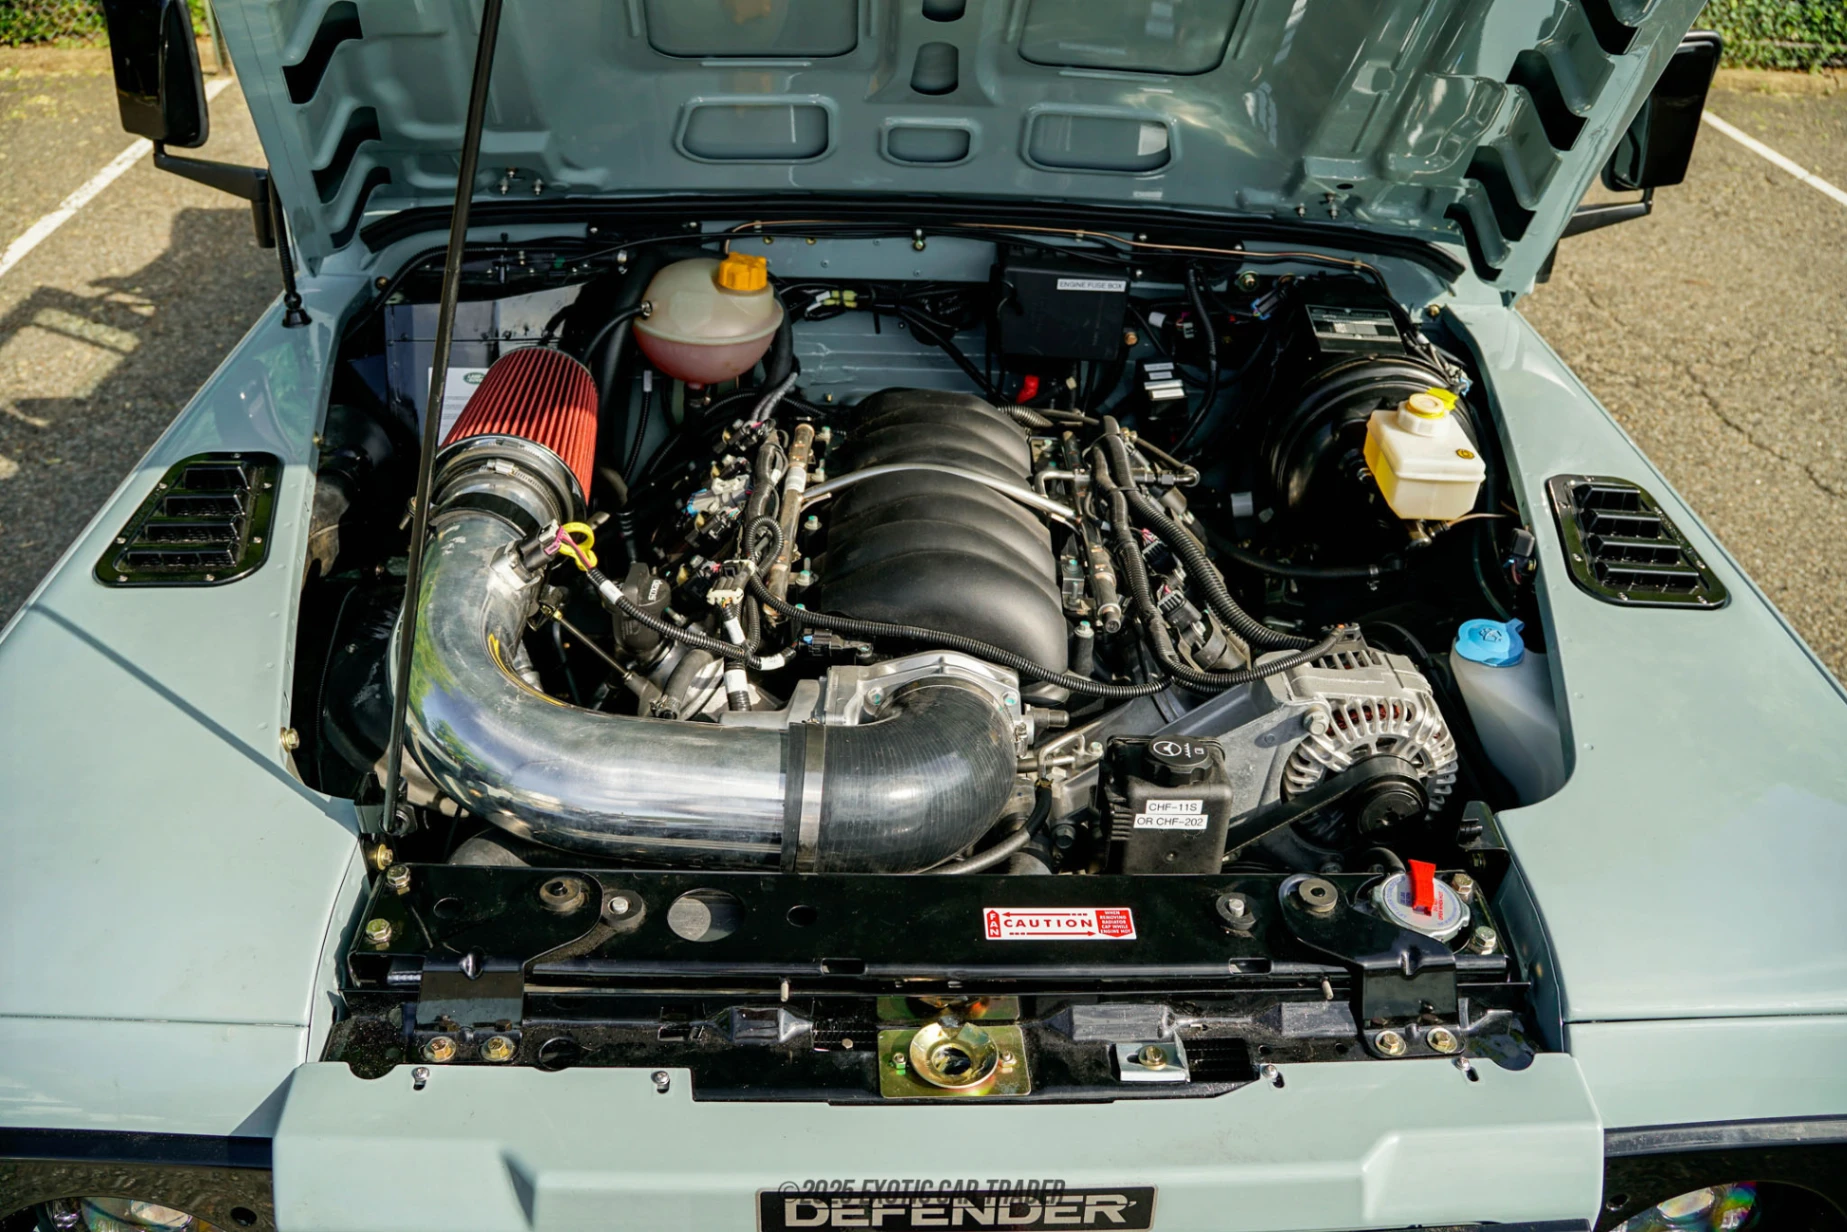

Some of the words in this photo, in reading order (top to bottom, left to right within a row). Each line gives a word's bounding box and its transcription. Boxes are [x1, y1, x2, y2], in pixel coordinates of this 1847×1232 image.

[1148, 802, 1197, 812] CHF-11S
[1136, 817, 1153, 826] OR
[1156, 817, 1204, 827] CHF-202
[989, 913, 1000, 936] FAN
[1003, 919, 1093, 928] CAUTION
[784, 1194, 1136, 1227] DEFENDER
